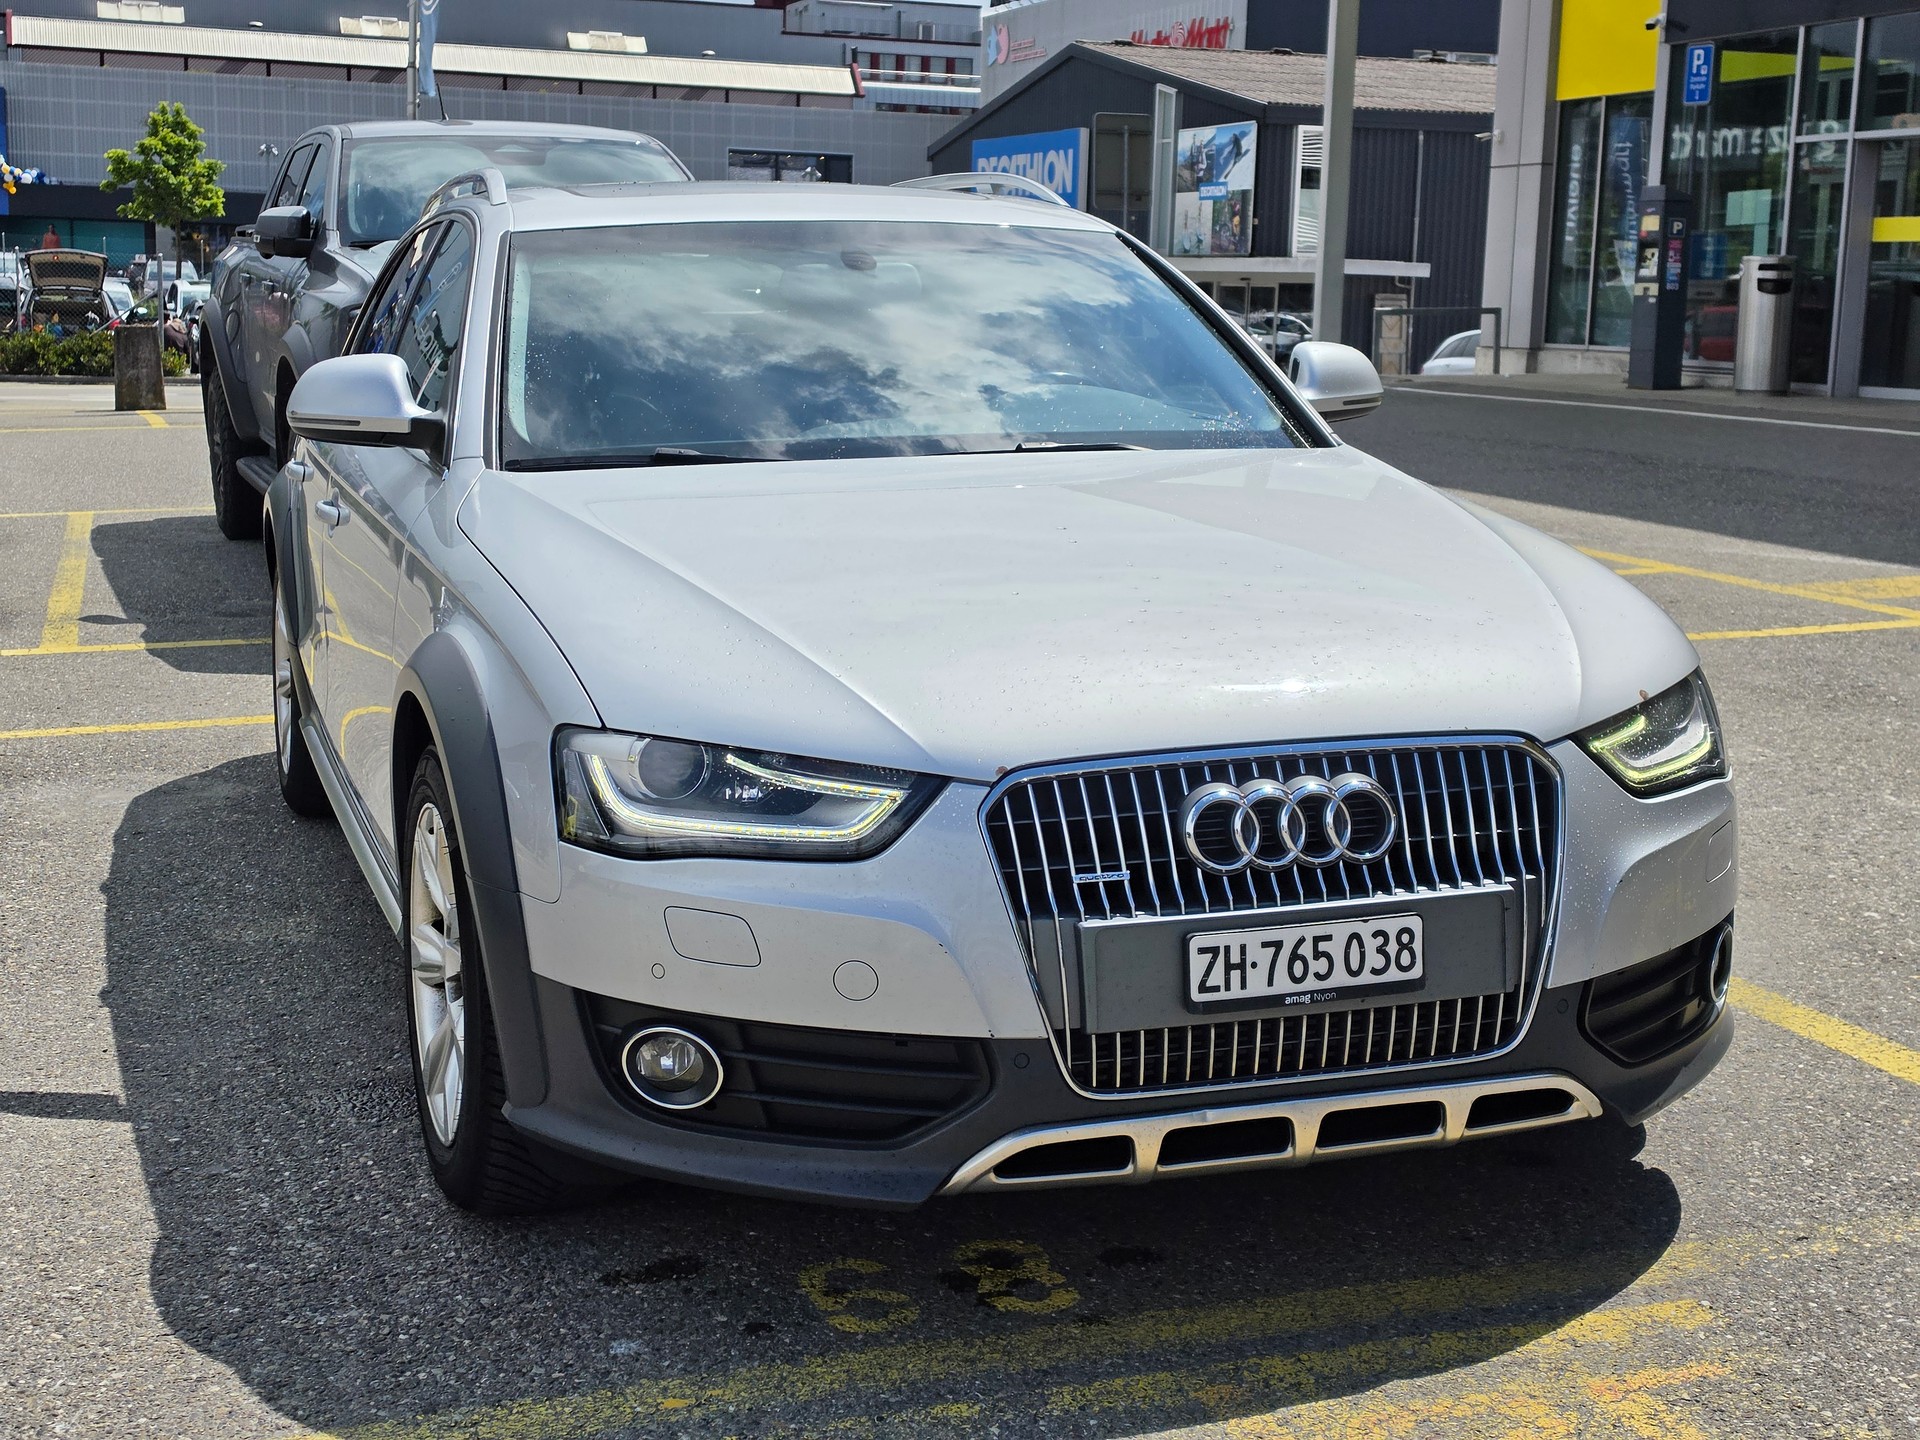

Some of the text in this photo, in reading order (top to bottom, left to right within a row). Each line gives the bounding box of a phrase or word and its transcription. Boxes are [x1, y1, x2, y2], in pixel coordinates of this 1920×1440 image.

[1692, 49, 1705, 75] P
[1673, 221, 1683, 236] P
[1284, 991, 1337, 1005] amag Nyon
